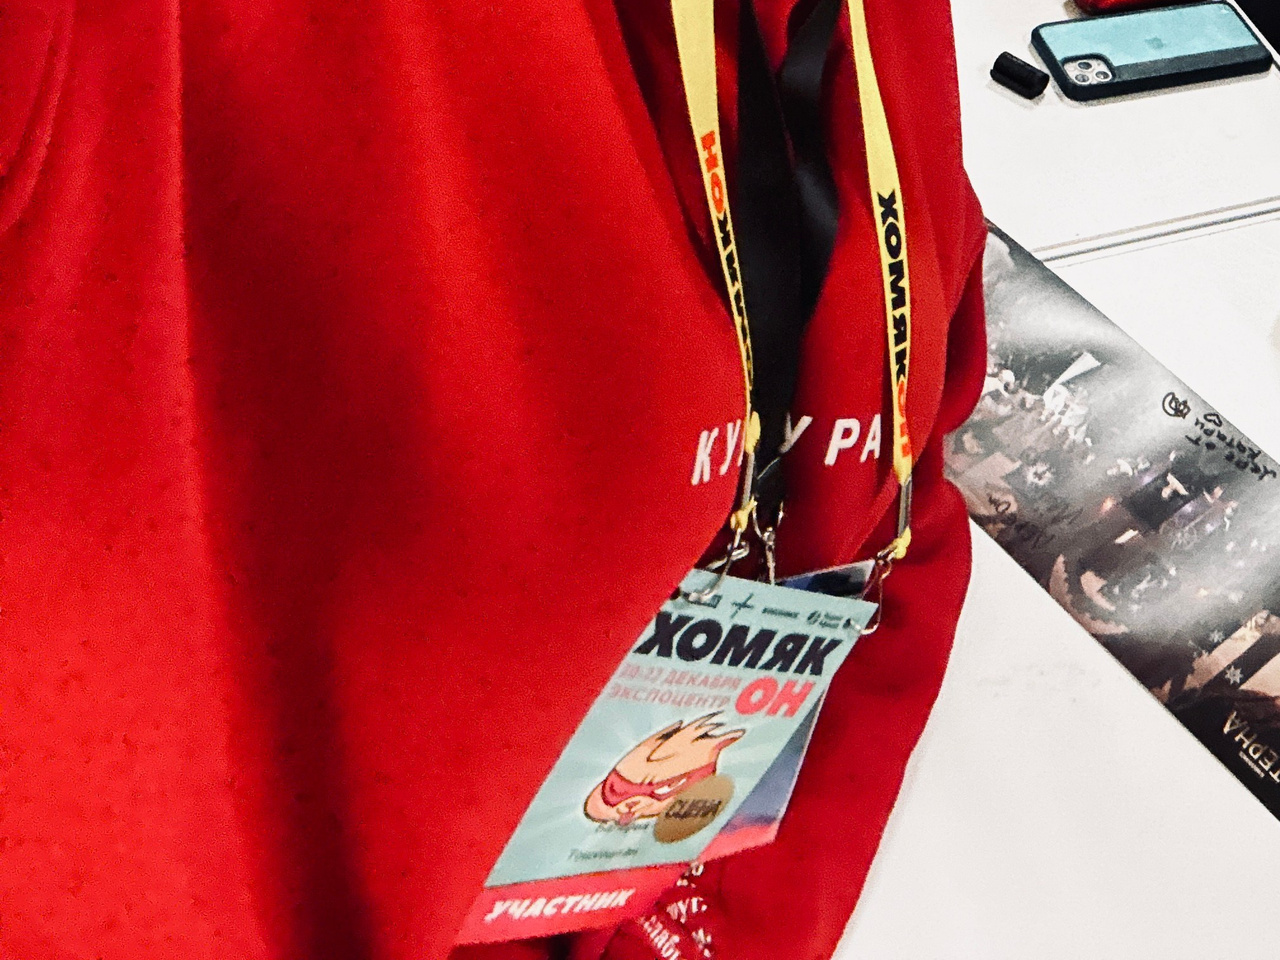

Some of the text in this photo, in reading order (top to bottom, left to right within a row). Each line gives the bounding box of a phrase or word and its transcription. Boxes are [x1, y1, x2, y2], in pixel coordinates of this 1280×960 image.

[632, 610, 843, 677] ХОМЯК
[734, 675, 815, 718] ОН
[483, 888, 637, 924] УЧАСТНИК
